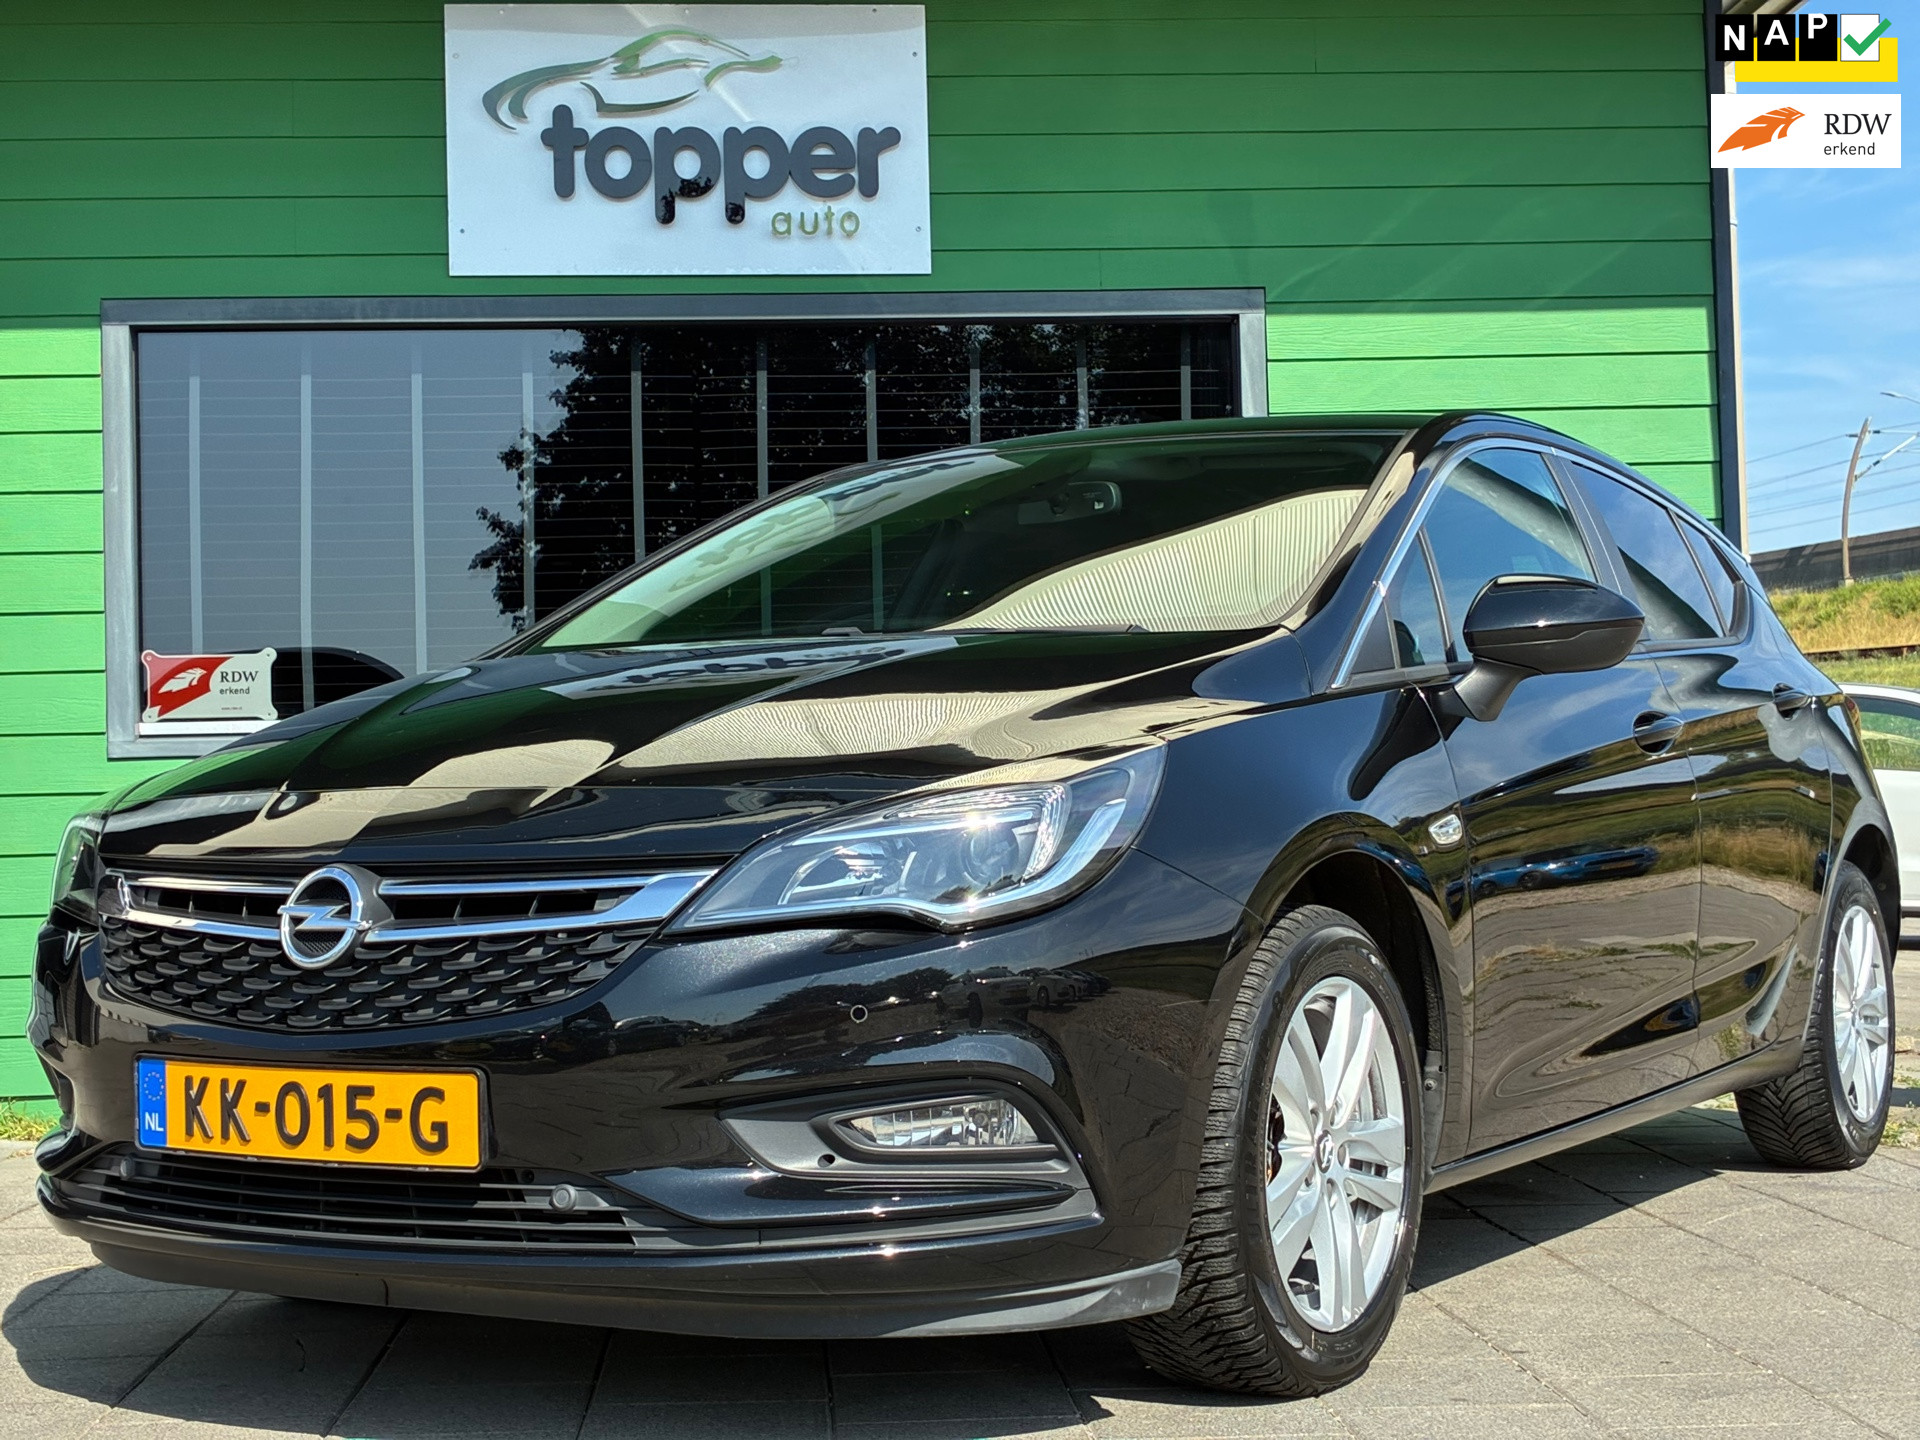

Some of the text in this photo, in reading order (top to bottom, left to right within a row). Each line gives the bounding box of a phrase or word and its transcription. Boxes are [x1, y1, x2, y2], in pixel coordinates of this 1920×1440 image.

[541, 104, 901, 225] topper
[771, 205, 861, 236] auto
[220, 671, 258, 683] RDW
[219, 686, 250, 695] erkend
[144, 1112, 164, 1132] NL
[184, 1075, 449, 1151] KK-015-G
